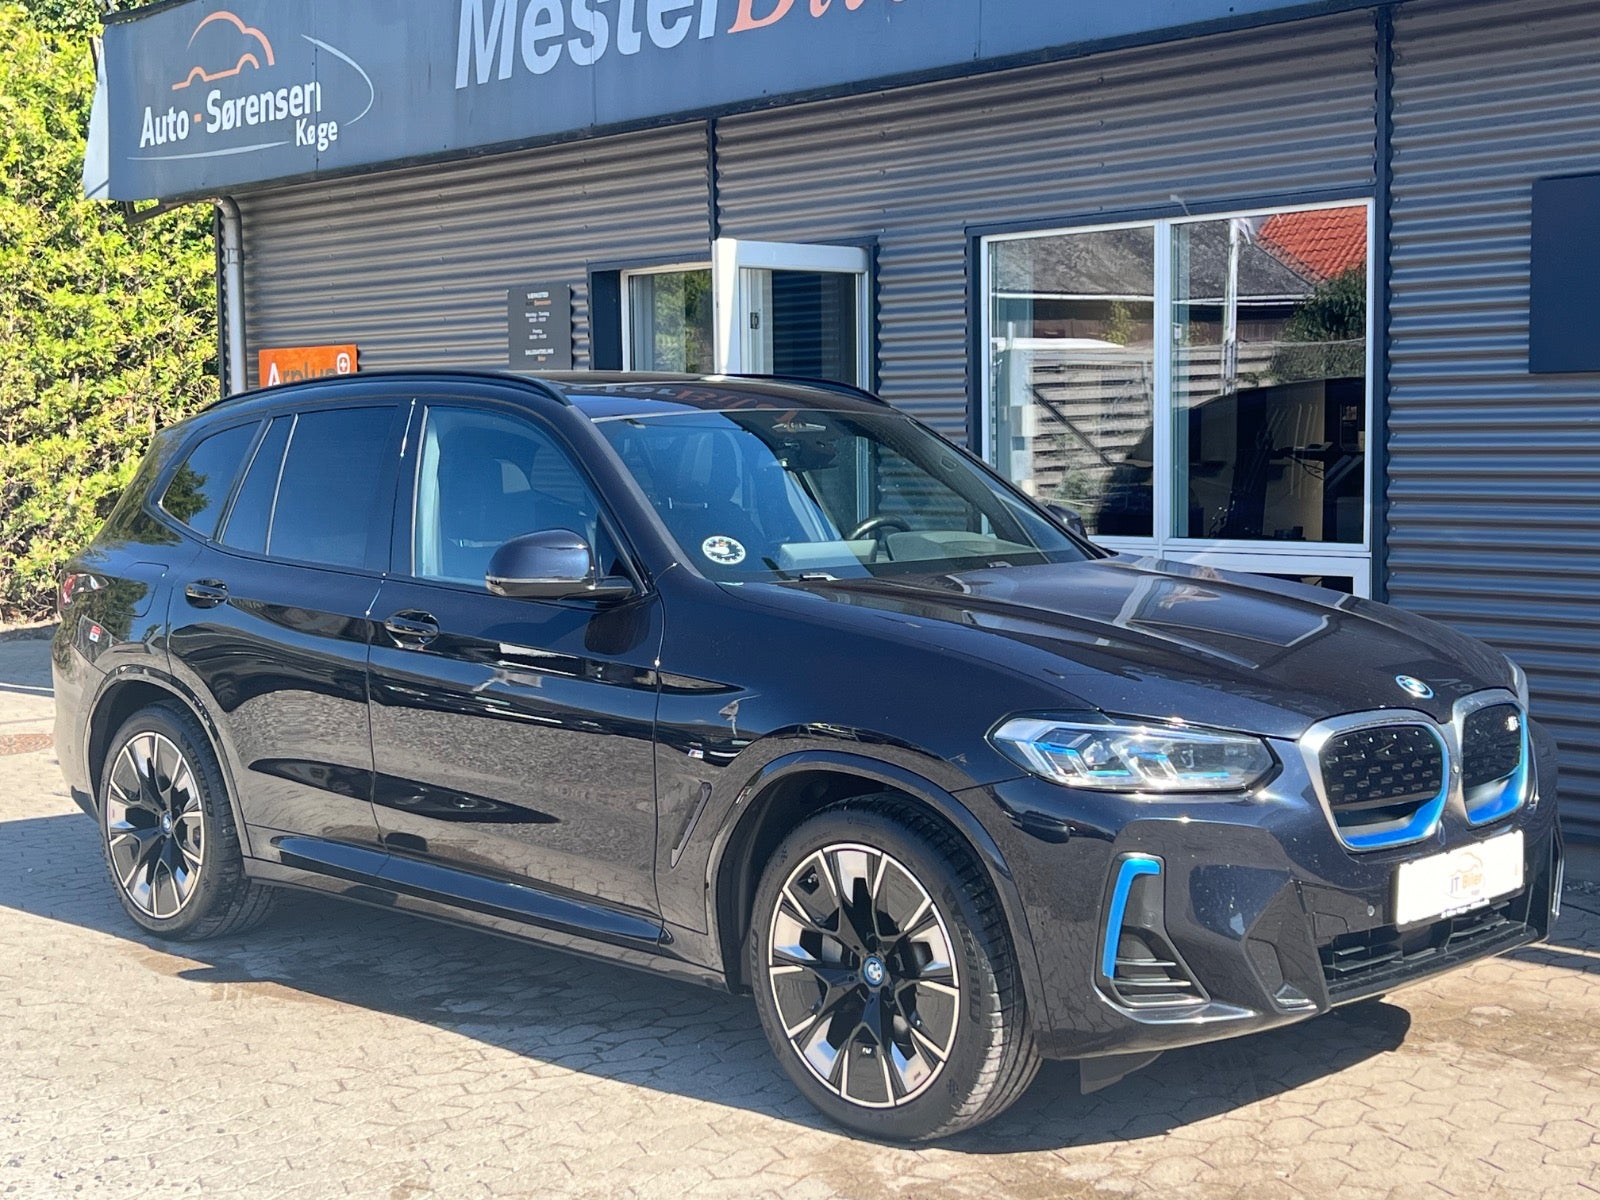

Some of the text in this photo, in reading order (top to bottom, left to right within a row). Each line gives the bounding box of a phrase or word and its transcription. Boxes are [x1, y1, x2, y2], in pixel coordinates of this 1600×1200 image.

[139, 81, 321, 148] Auto Sørensen
[295, 118, 338, 151] Køge
